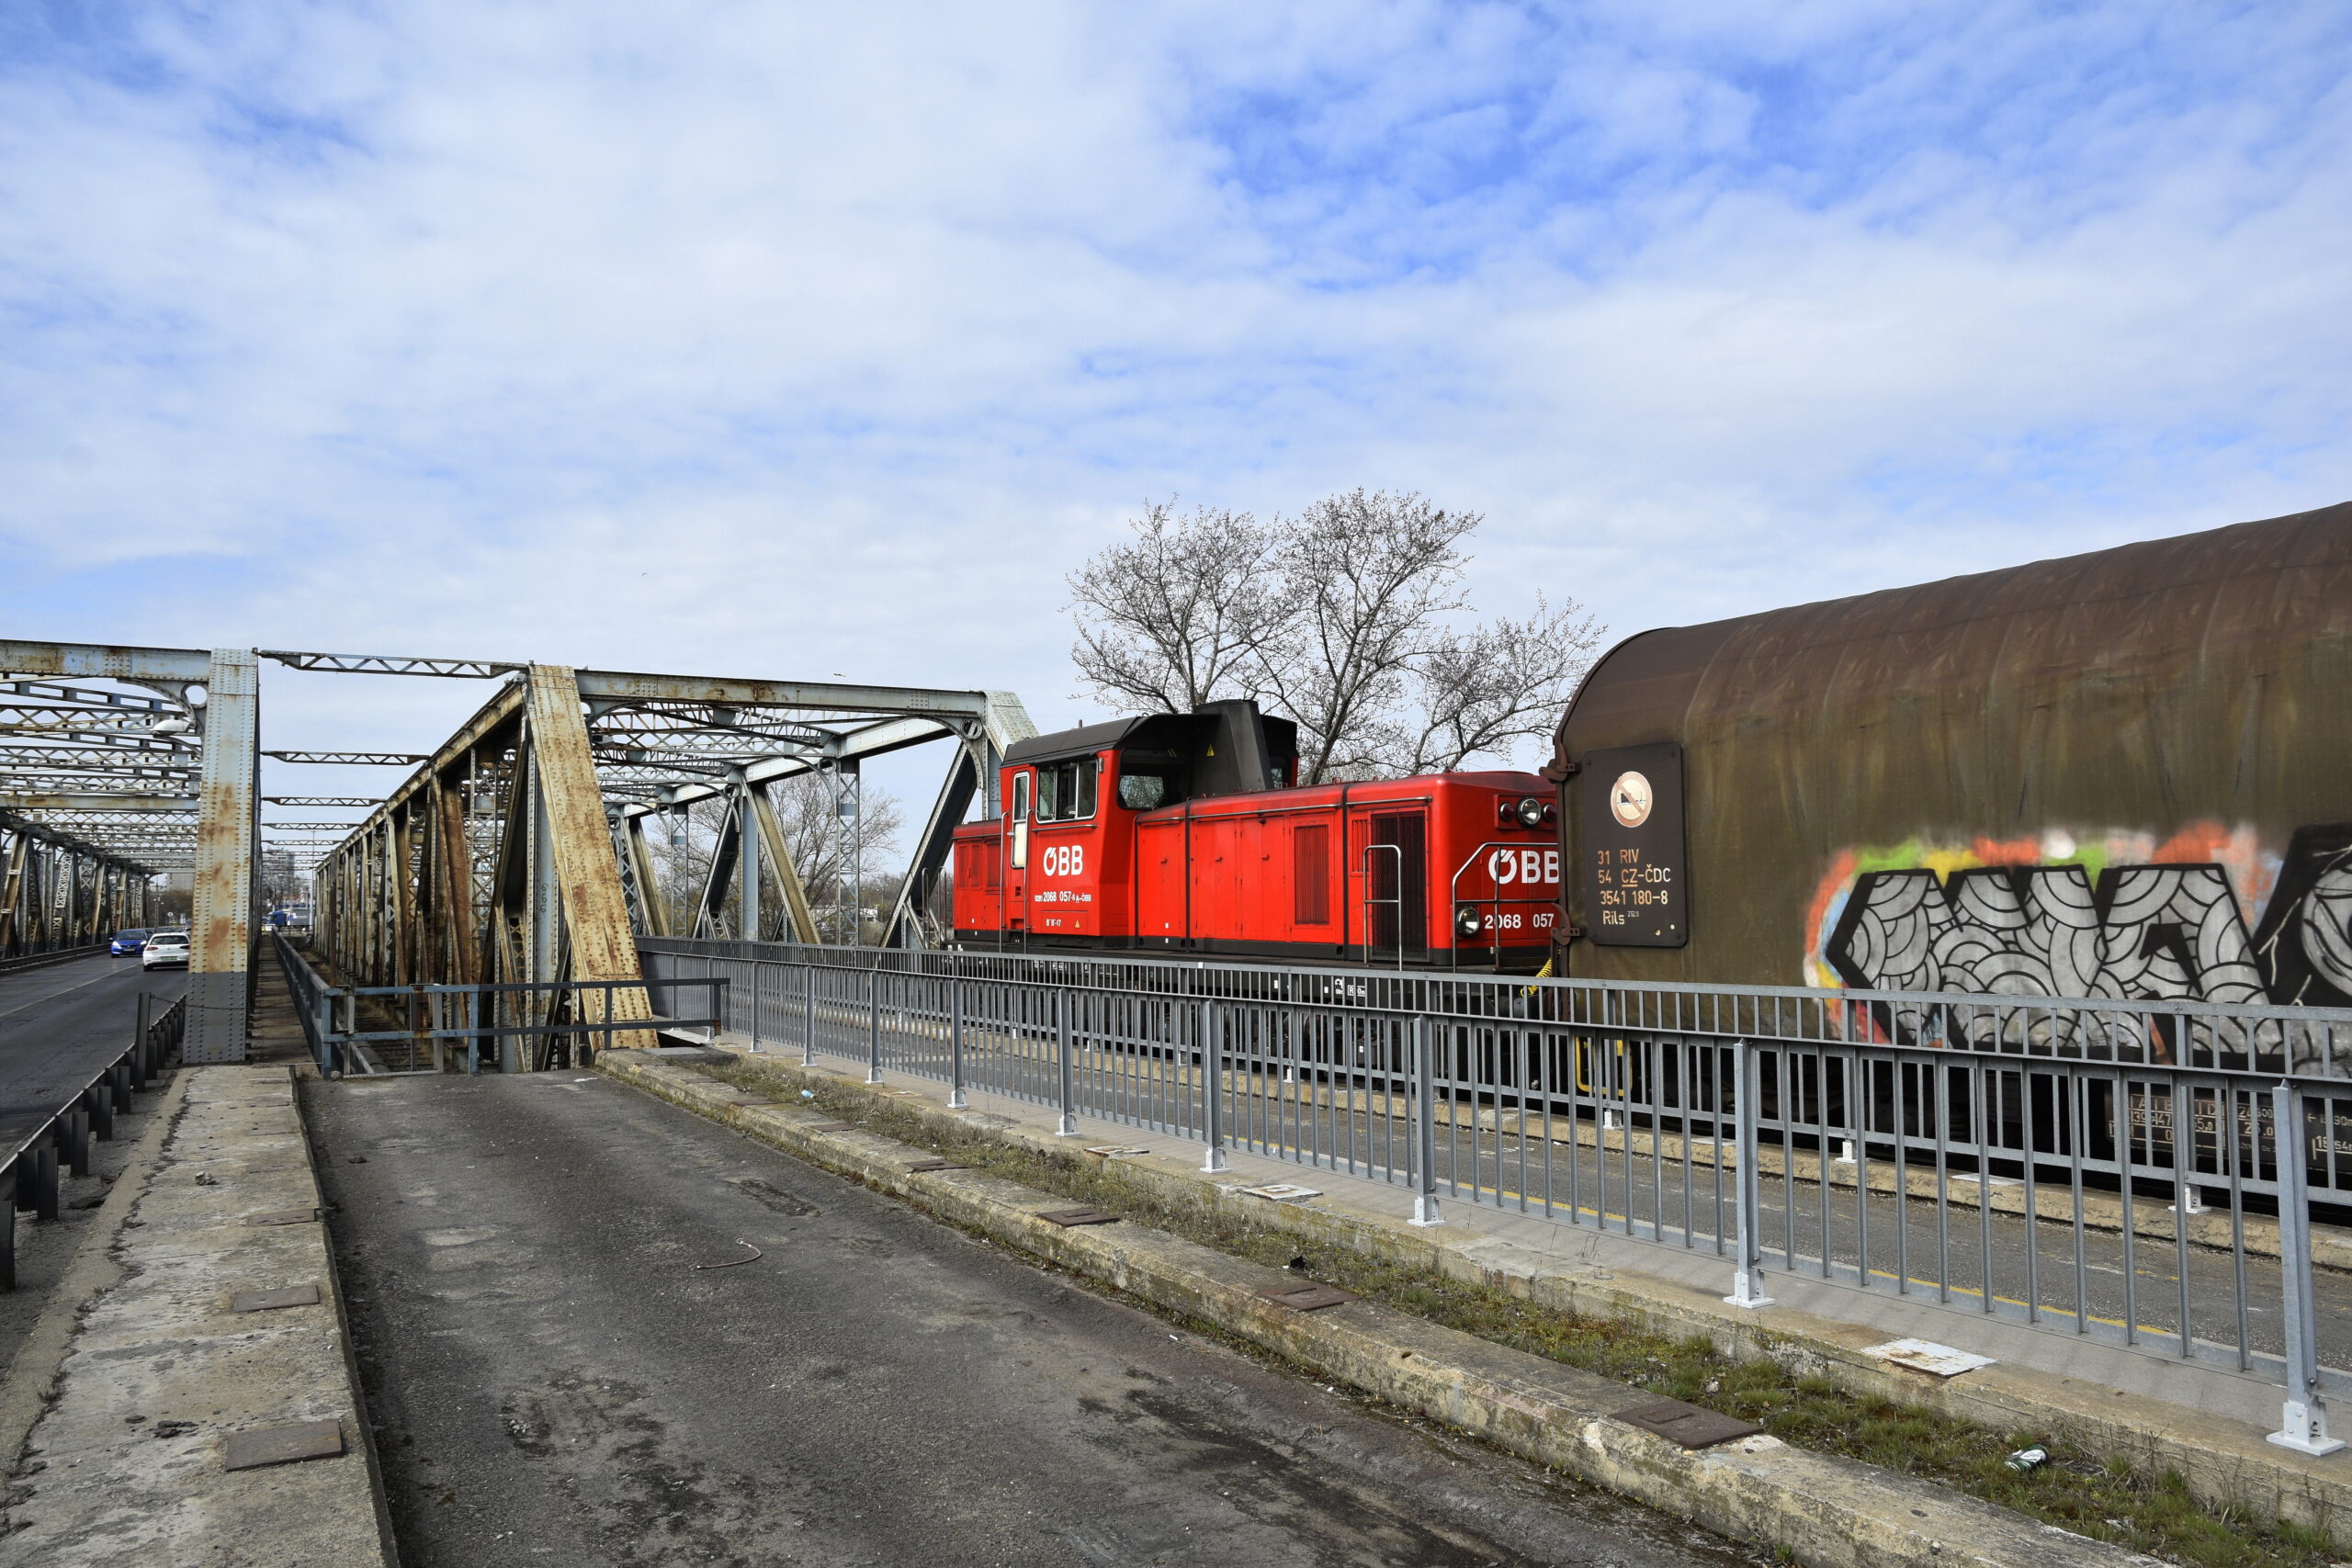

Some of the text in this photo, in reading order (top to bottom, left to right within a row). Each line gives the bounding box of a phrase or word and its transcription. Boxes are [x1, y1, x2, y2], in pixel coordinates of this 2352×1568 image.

[1044, 845, 1083, 876] ÖBB
[1598, 849, 1639, 864] 31 RIV
[1599, 863, 1671, 887] 54 CZ-ČDC
[1600, 890, 1668, 905] 3541 180-8
[1532, 913, 1555, 928] 057
[1602, 910, 1625, 925] Rils
